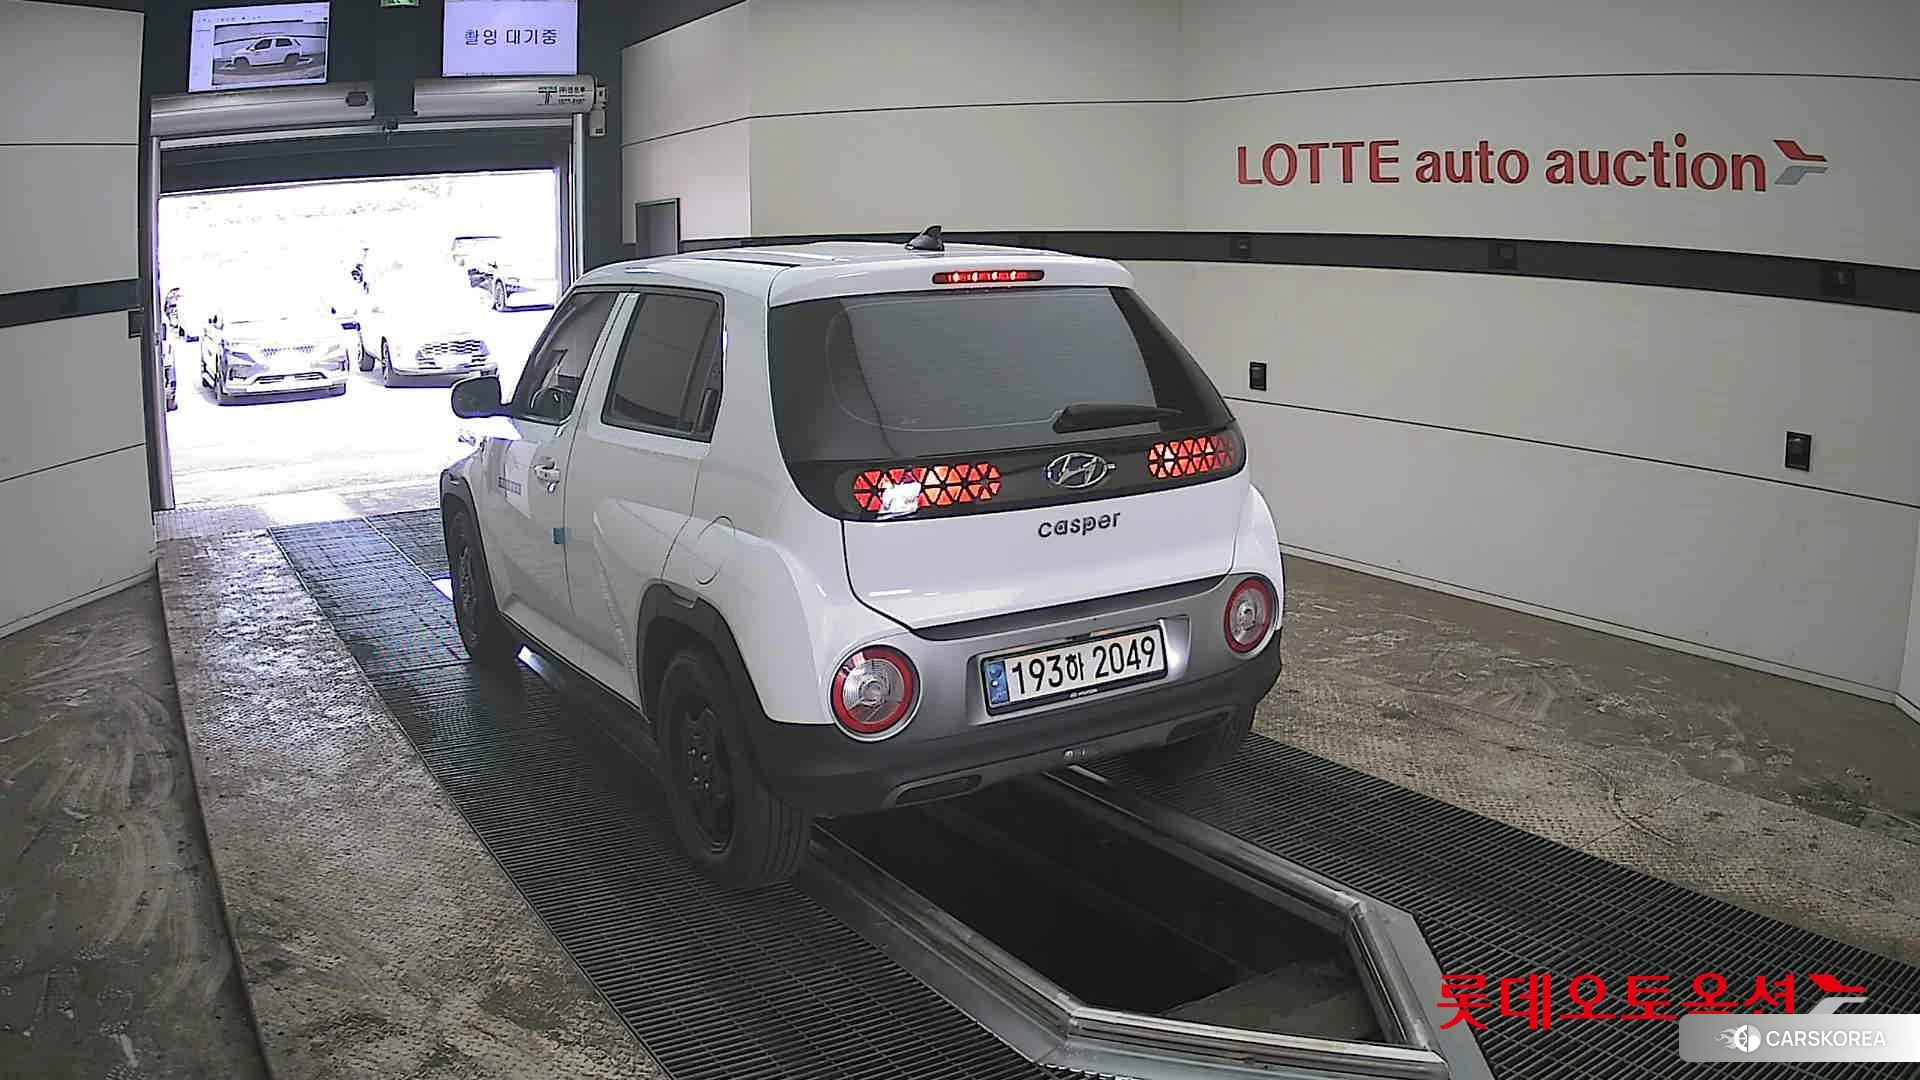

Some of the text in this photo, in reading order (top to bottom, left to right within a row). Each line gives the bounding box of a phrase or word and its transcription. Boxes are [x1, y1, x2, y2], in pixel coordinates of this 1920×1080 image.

[506, 28, 558, 46] 대기중
[1237, 132, 1767, 192] LOTTE auto auction
[1038, 512, 1121, 538] casper
[1012, 635, 1156, 695] 193하 2049
